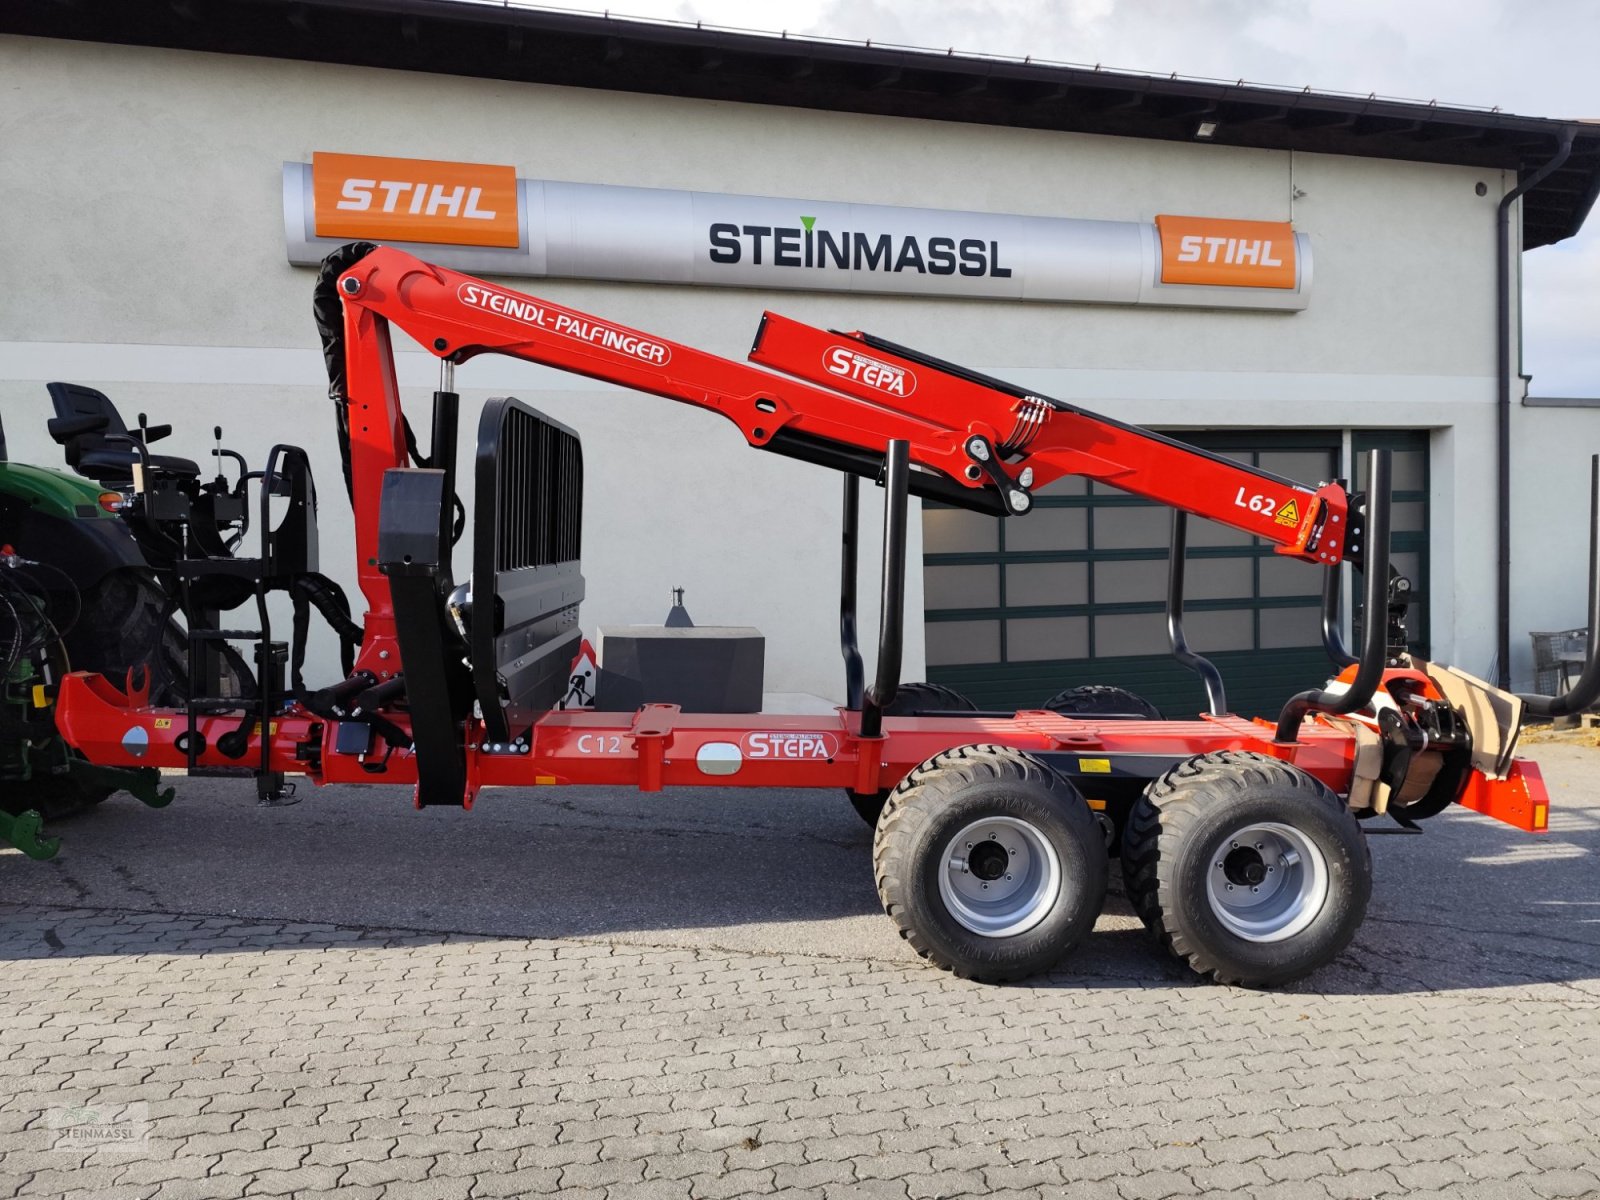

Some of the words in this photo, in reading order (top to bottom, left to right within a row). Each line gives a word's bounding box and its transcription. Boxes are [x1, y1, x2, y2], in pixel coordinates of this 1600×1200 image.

[336, 178, 497, 220] STIHL
[709, 222, 1012, 279] STEINMASSL
[1177, 235, 1282, 267] STIHL
[464, 286, 665, 363] STEINDL-PALFINGER
[829, 349, 904, 395] STEPA
[1234, 487, 1276, 516] L62
[749, 733, 829, 758] STEPA
